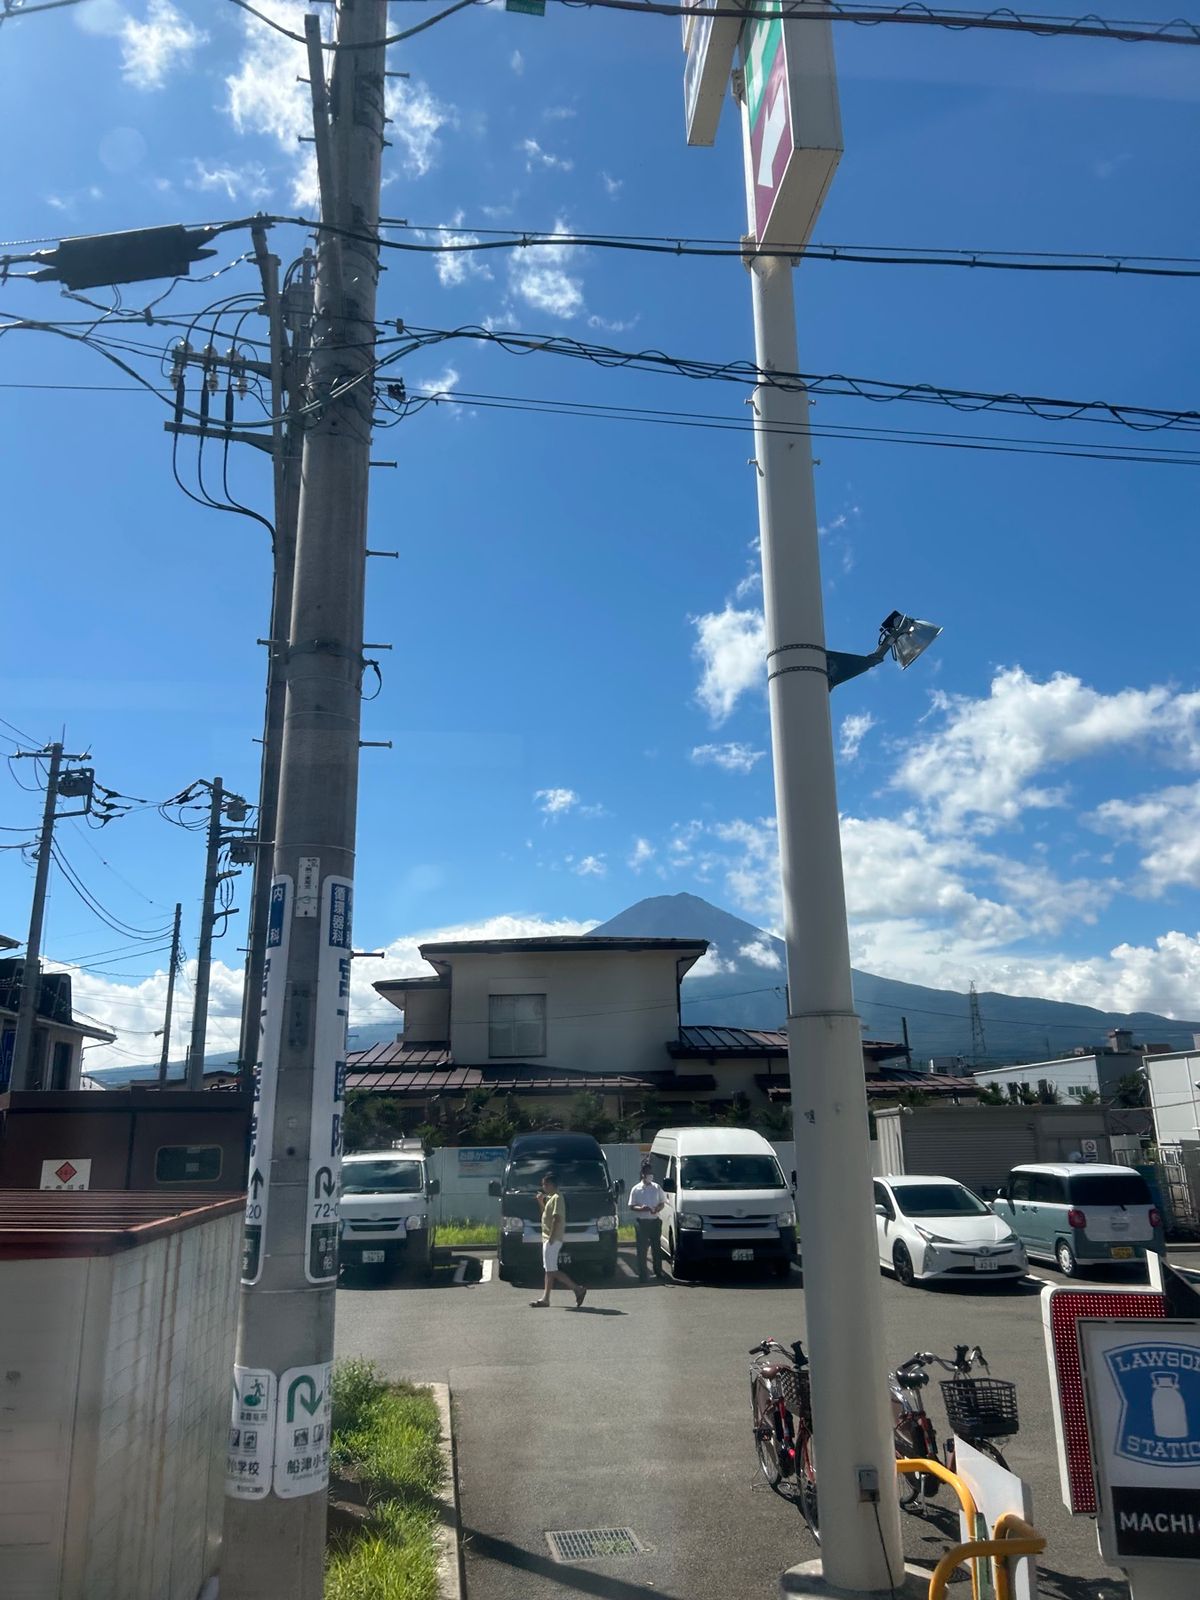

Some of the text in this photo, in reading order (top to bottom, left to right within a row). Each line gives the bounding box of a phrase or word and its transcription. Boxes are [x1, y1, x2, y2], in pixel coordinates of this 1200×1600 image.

[270, 887, 283, 943] 内科
[332, 886, 345, 944] 循環器科
[246, 1204, 262, 1219] 20
[1120, 1511, 1194, 1534] MACHI
